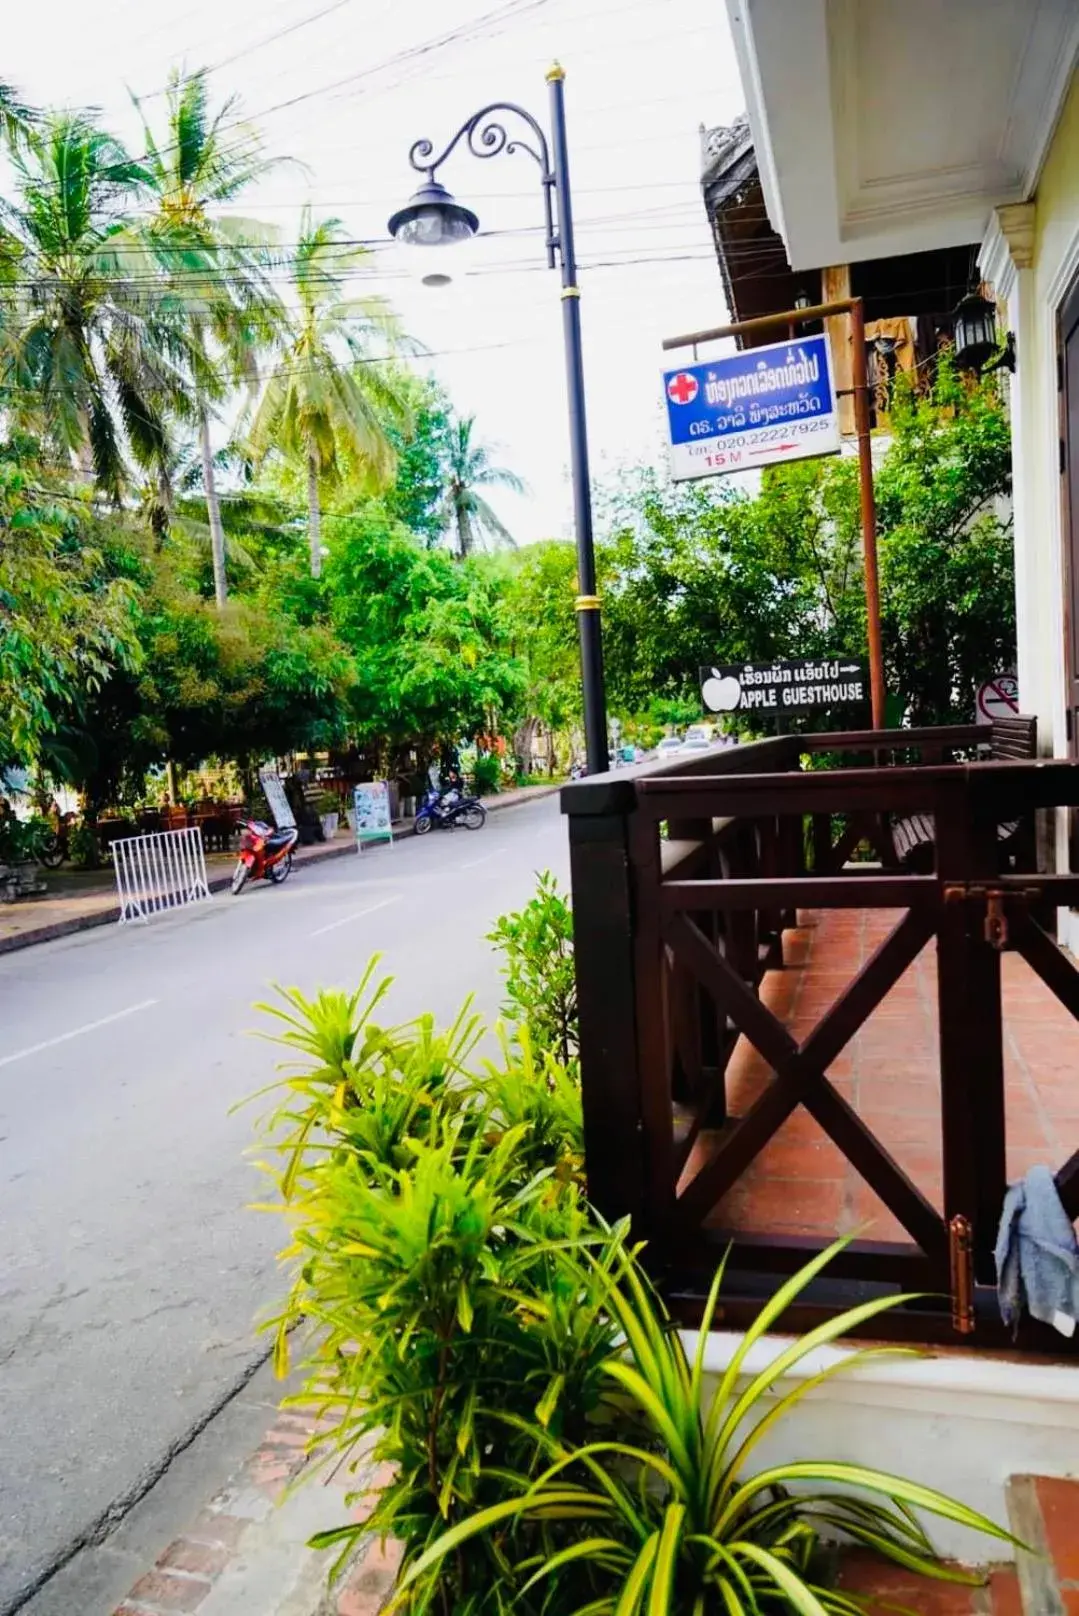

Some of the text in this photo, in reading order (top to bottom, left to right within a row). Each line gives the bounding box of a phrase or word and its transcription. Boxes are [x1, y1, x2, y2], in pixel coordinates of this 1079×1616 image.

[717, 419, 830, 450] 020.22227925
[705, 451, 742, 467] 15 M
[739, 682, 864, 709] APPLE GUESTHOUSE
